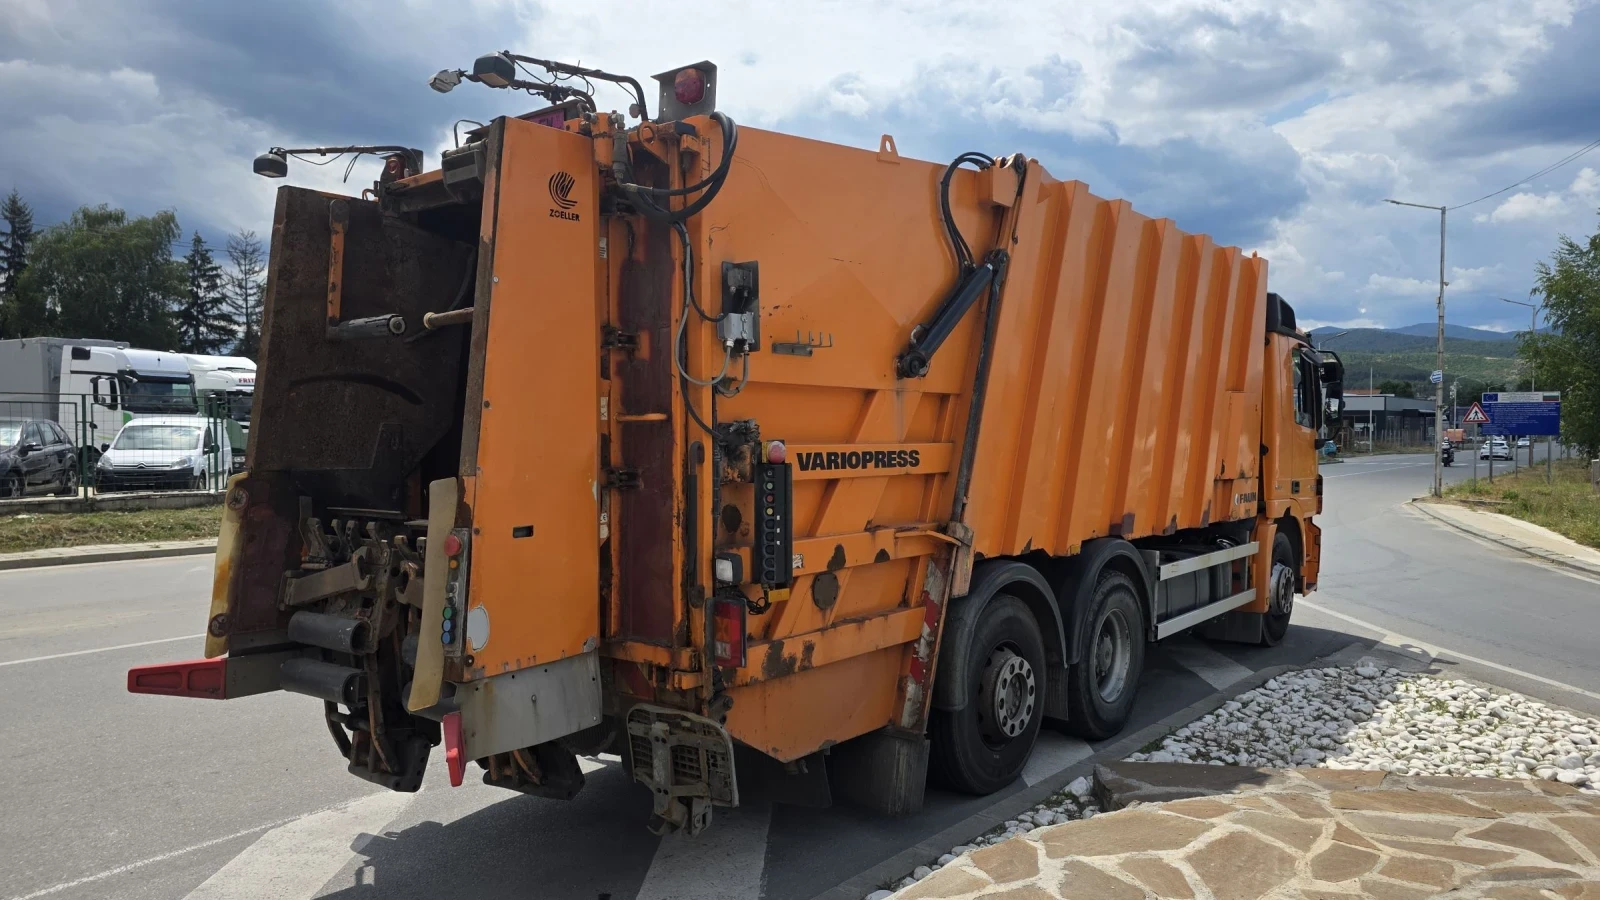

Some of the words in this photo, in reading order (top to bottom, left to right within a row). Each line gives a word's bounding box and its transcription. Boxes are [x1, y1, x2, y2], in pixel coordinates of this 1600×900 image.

[549, 209, 580, 221] ZOELLER
[796, 450, 920, 471] VARIOPRESS
[1239, 491, 1257, 504] FAUN
